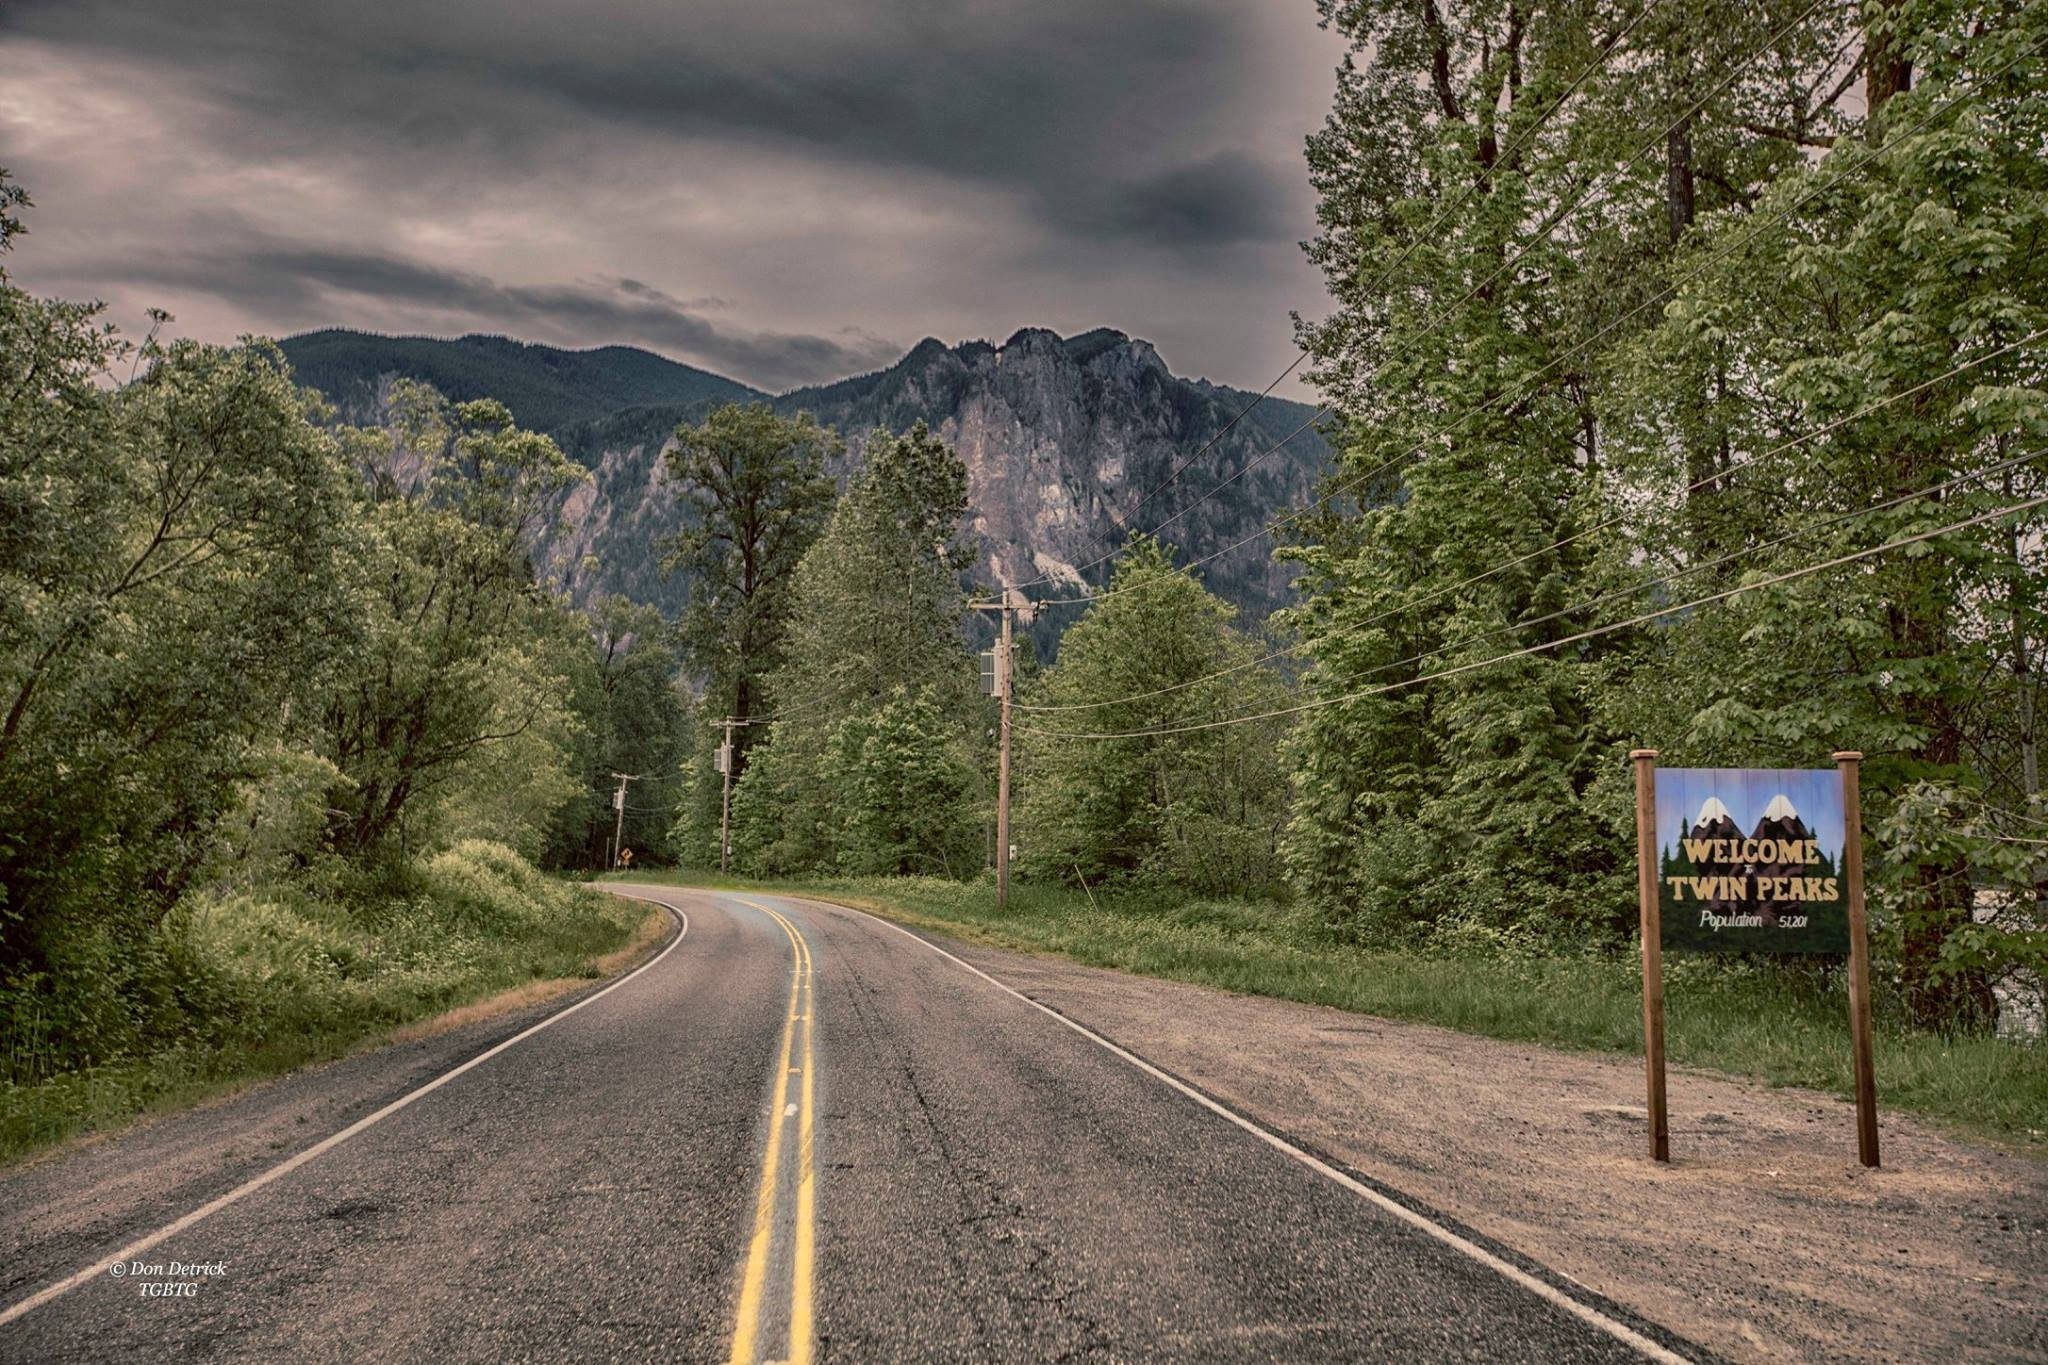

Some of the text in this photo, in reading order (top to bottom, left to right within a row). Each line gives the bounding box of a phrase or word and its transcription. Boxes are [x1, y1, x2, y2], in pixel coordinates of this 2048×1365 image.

[1682, 838, 1820, 865] WELCOME
[1666, 876, 1839, 902] TWIN PEAKS
[1699, 910, 1763, 932] Population
